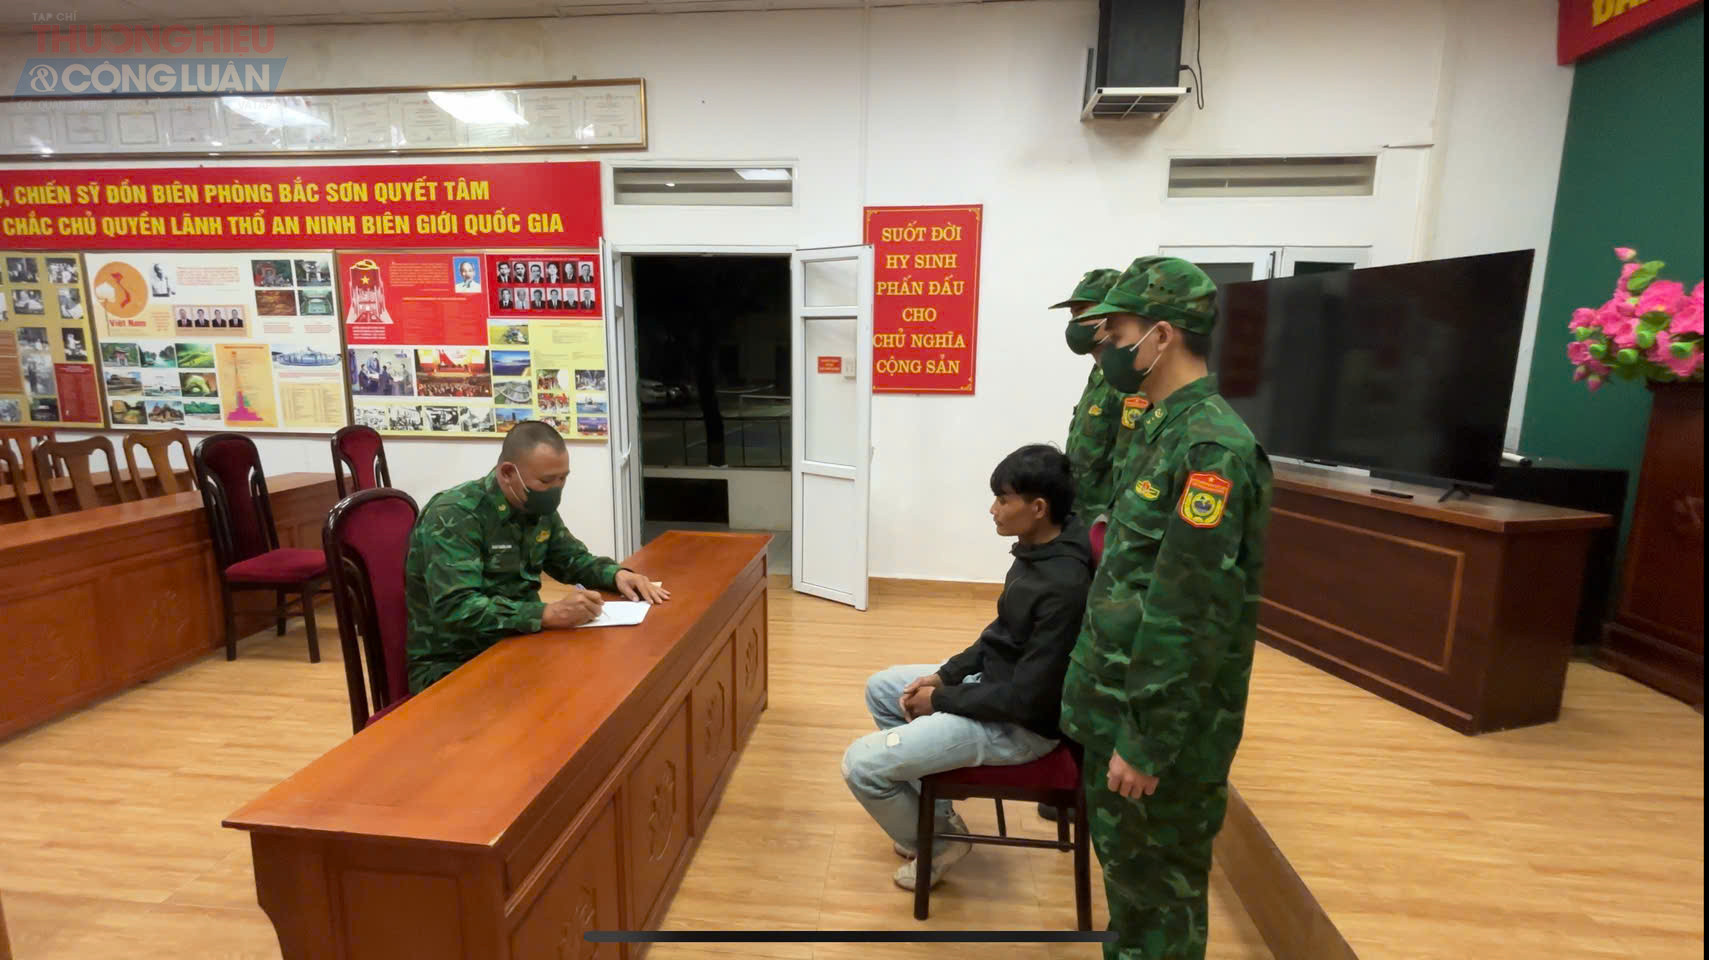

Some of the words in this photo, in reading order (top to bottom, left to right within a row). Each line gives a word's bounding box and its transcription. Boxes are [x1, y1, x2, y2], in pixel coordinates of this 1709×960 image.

[14, 180, 72, 205] CHIẾN
[76, 182, 99, 205] SỸ
[105, 179, 148, 205] ĐỒN
[152, 180, 199, 204] BIÊN
[203, 180, 274, 204] PHÒNG
[278, 176, 320, 203] BẮC
[325, 182, 369, 203] SƠN
[374, 176, 438, 204] QUYẾT
[443, 178, 490, 201] TÂM
[57, 211, 97, 236] CHỦ
[170, 213, 223, 236] LÃNH
[227, 209, 266, 236] THỔ
[272, 216, 300, 235] AN
[305, 215, 357, 235] NINH
[361, 212, 410, 235] BIÊN
[416, 211, 459, 235] GIỚI
[464, 208, 521, 236] QUỐC
[527, 213, 565, 233] GIA
[882, 221, 927, 242] SUỐT
[931, 222, 962, 241] ĐỜI
[886, 254, 910, 269] HY
[914, 254, 957, 268] SINH
[876, 275, 924, 296] PHẤN
[928, 274, 965, 296] ĐẤU
[902, 308, 937, 322] CHO
[873, 328, 906, 348] CHỦ
[910, 331, 966, 348] NGHĨA
[876, 356, 922, 376] CỘNG
[926, 354, 961, 374] SẢN
